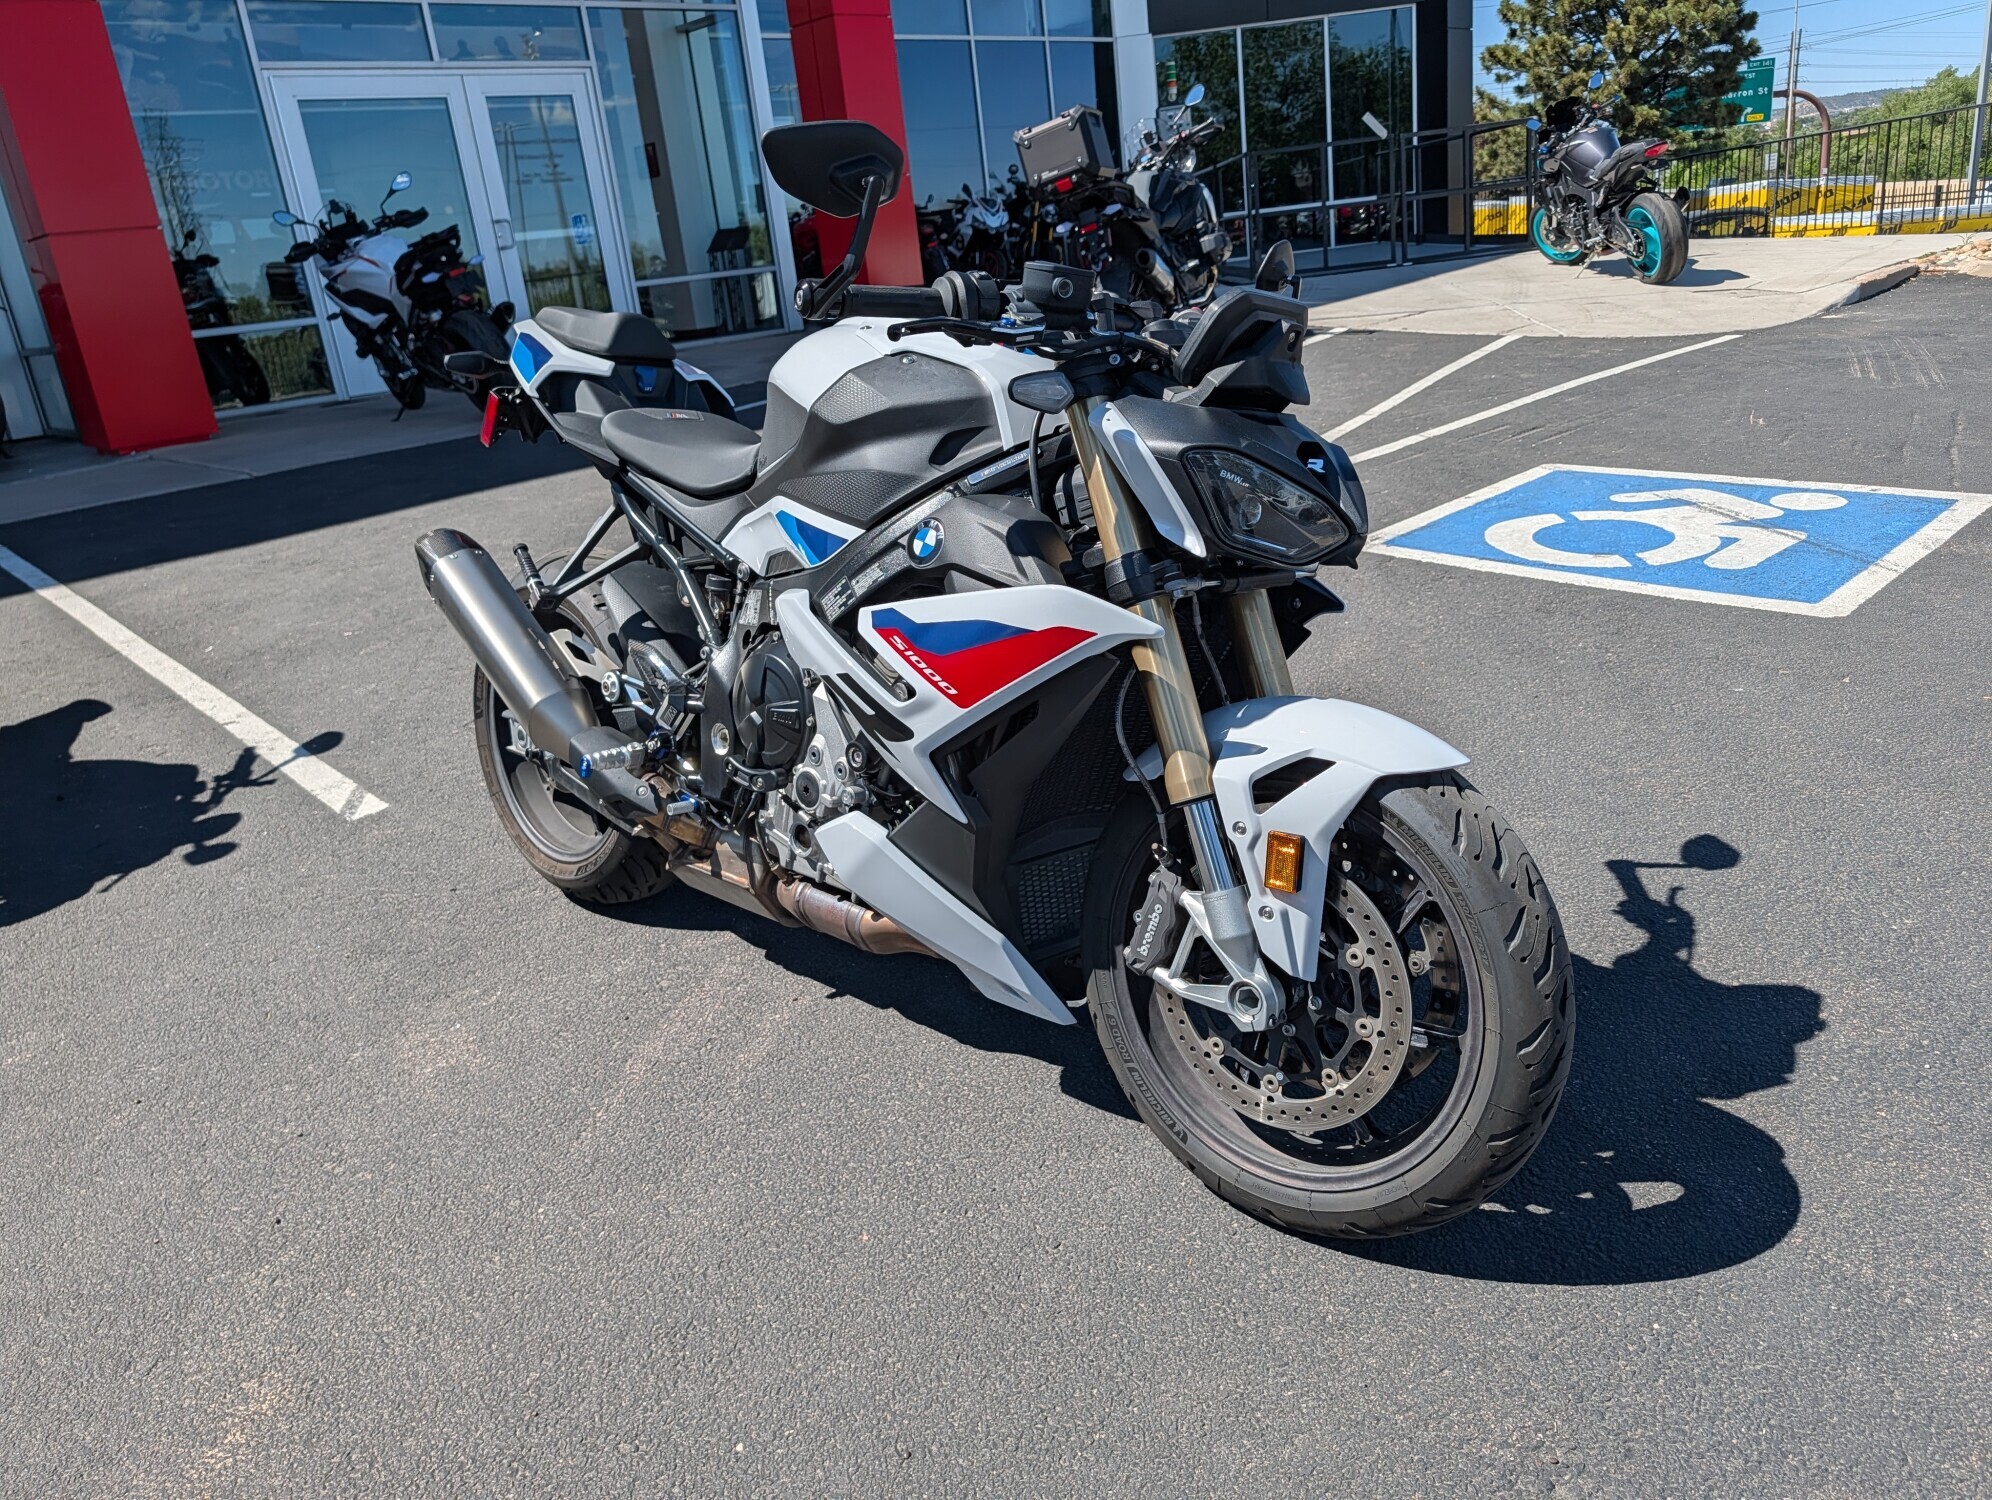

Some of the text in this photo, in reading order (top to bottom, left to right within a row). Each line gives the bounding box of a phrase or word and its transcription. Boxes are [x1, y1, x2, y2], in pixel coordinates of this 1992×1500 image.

[1758, 87, 1769, 95] St
[1220, 470, 1243, 484] BMW
[889, 635, 959, 695] S1000
[1400, 822, 1457, 886] MICHELIN
[1137, 904, 1163, 957] brembo
[1113, 1028, 1133, 1064] ROAD
[1131, 1070, 1177, 1129] MICHELIN
